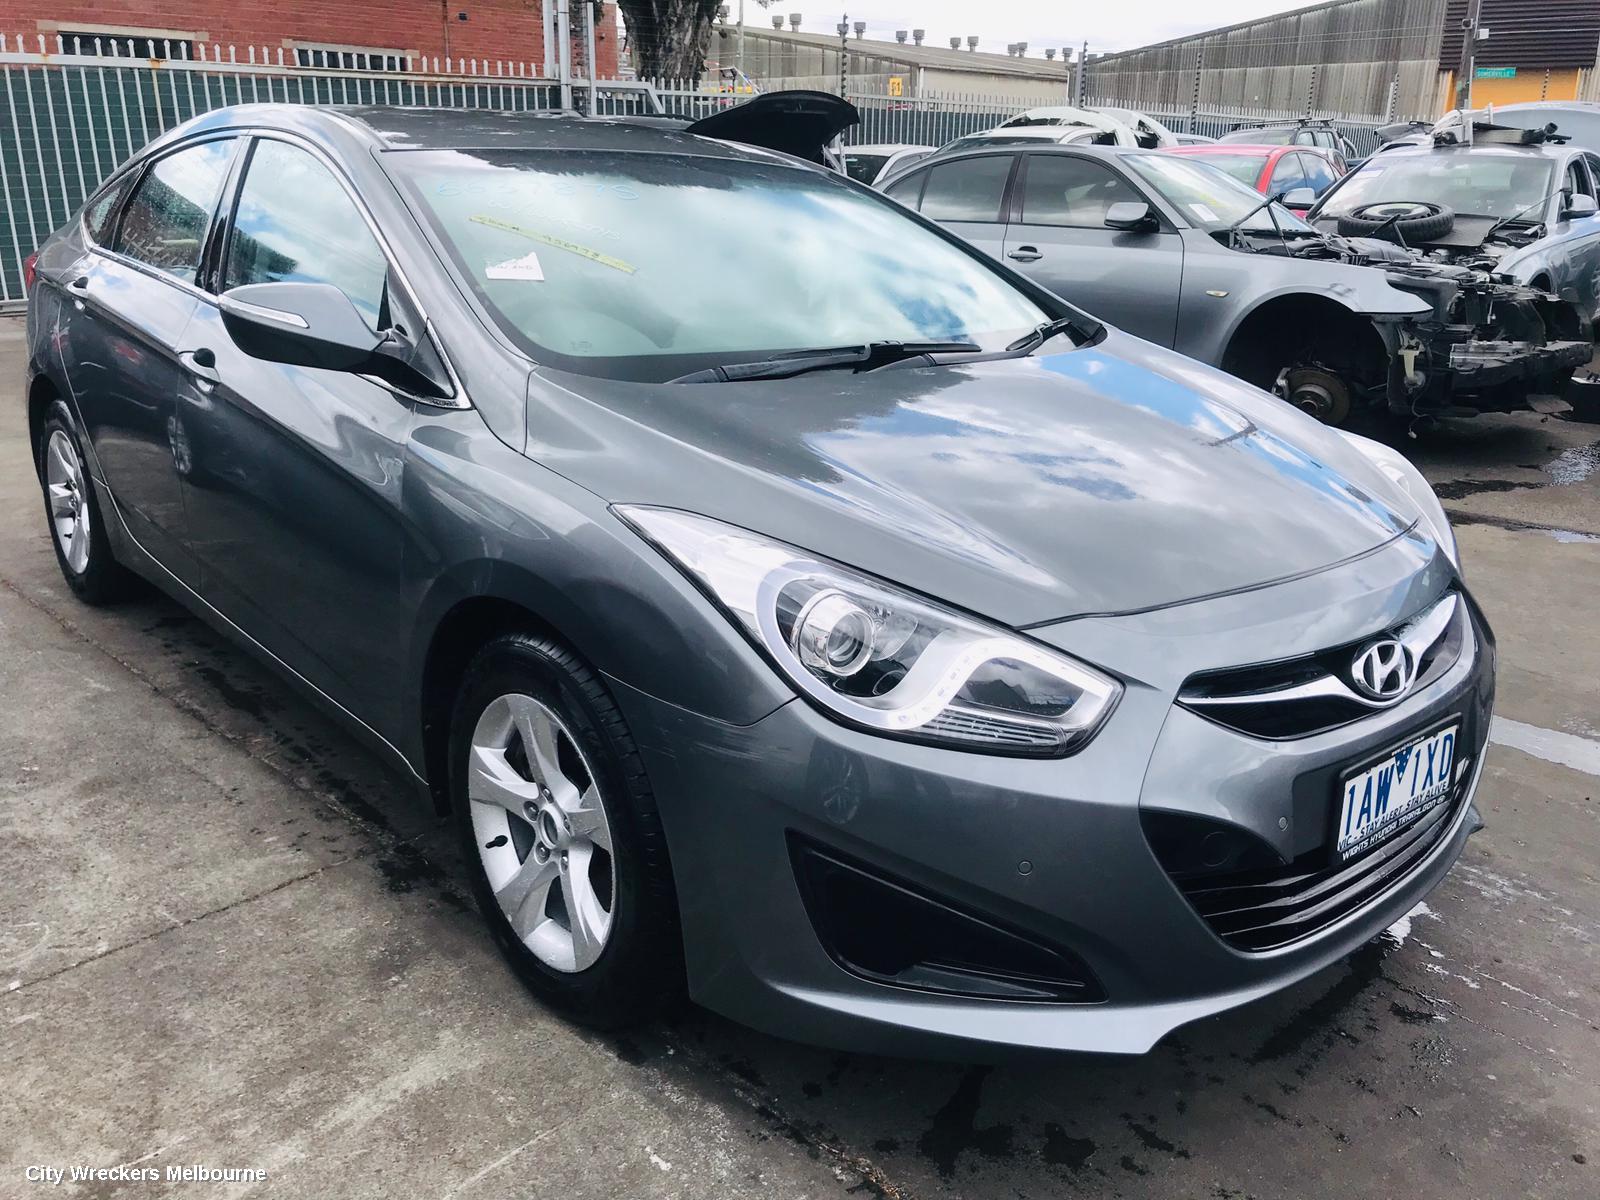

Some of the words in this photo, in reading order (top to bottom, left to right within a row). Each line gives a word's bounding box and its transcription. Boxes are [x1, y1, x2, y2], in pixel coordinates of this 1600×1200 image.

[1345, 764, 1395, 836] 1AW
[1411, 733, 1454, 796] 1XD
[1339, 834, 1353, 850] VIC
[1360, 818, 1379, 837] STAY
[1406, 791, 1425, 810] STAY
[1342, 838, 1369, 860] WIGHTS
[1370, 821, 1397, 841] HYUNDAI
